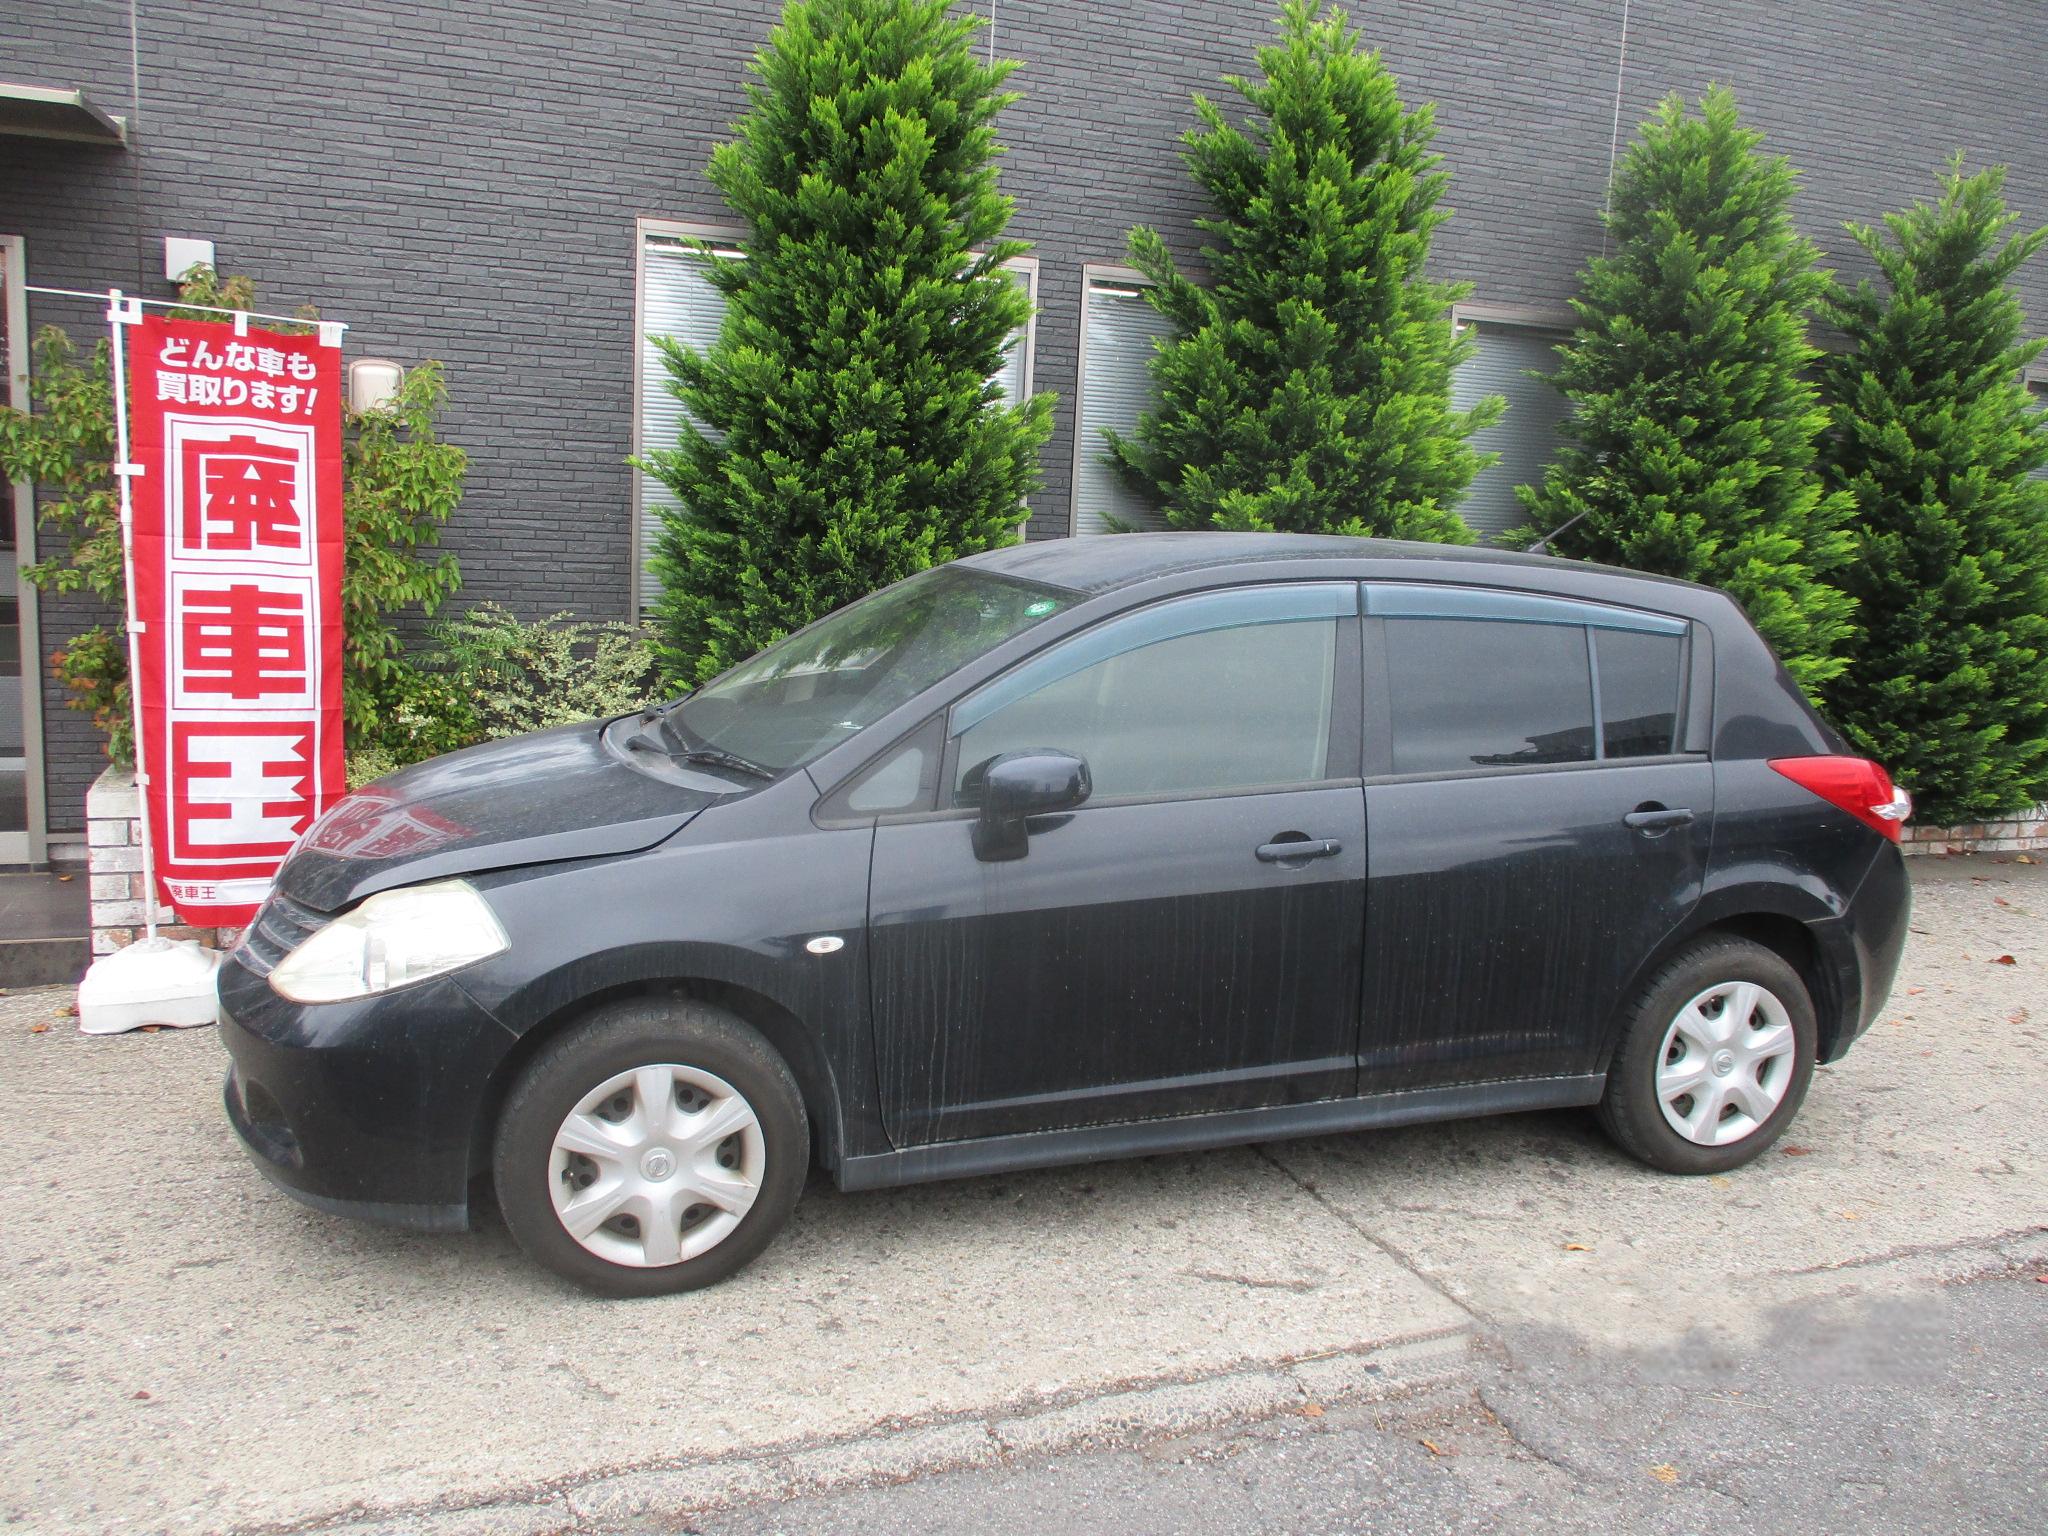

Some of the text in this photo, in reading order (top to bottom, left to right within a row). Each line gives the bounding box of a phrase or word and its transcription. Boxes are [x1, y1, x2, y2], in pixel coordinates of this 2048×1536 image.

[158, 336, 317, 381] どんな車も
[155, 369, 318, 416] 買取ります!
[182, 434, 307, 846] 廃車王
